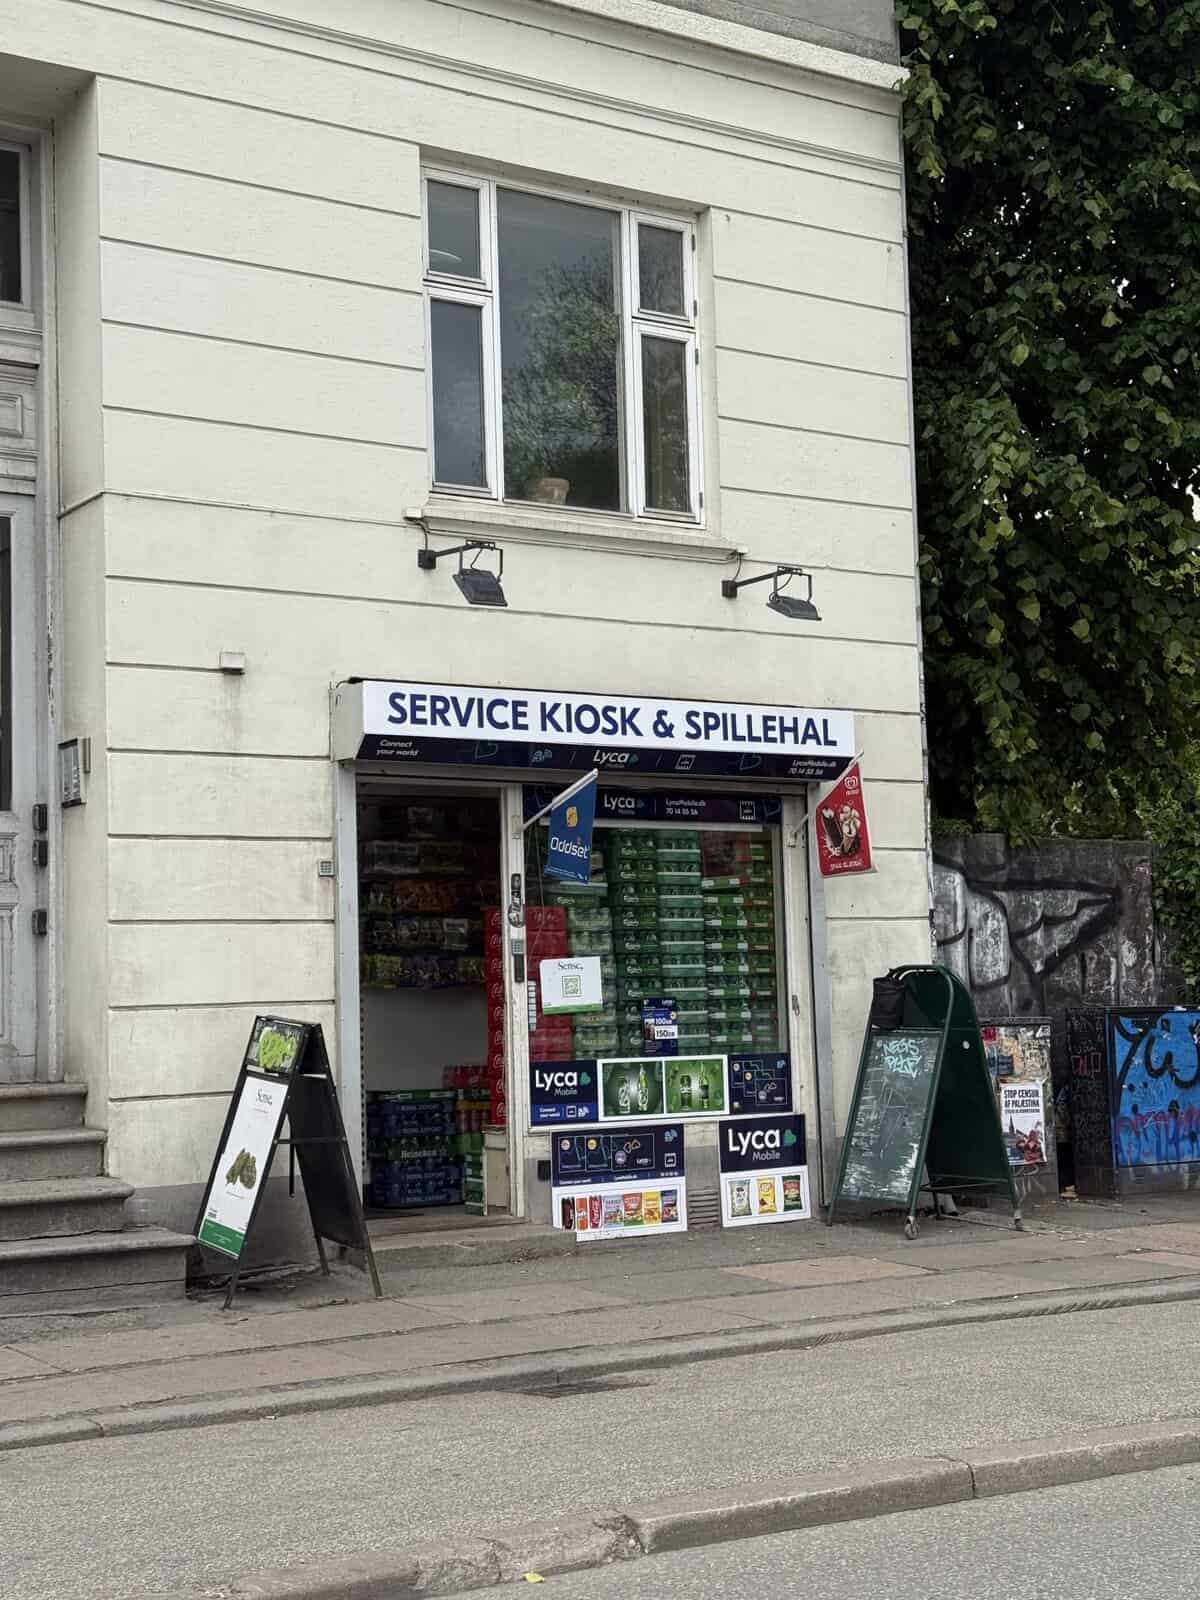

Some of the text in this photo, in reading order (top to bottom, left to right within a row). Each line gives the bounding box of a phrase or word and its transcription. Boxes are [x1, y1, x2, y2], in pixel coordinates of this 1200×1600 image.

[387, 692, 838, 746] SERVICE KIOSK & SPILLEHAL
[593, 750, 630, 764] Lyca
[604, 793, 635, 810] Lyca
[550, 836, 590, 859] Oddset
[535, 1070, 578, 1091] Lyca
[554, 1087, 578, 1097] Mobile
[1004, 1089, 1017, 1098] STOP
[728, 1128, 780, 1156] Lyca
[752, 1150, 781, 1161] Mobile
